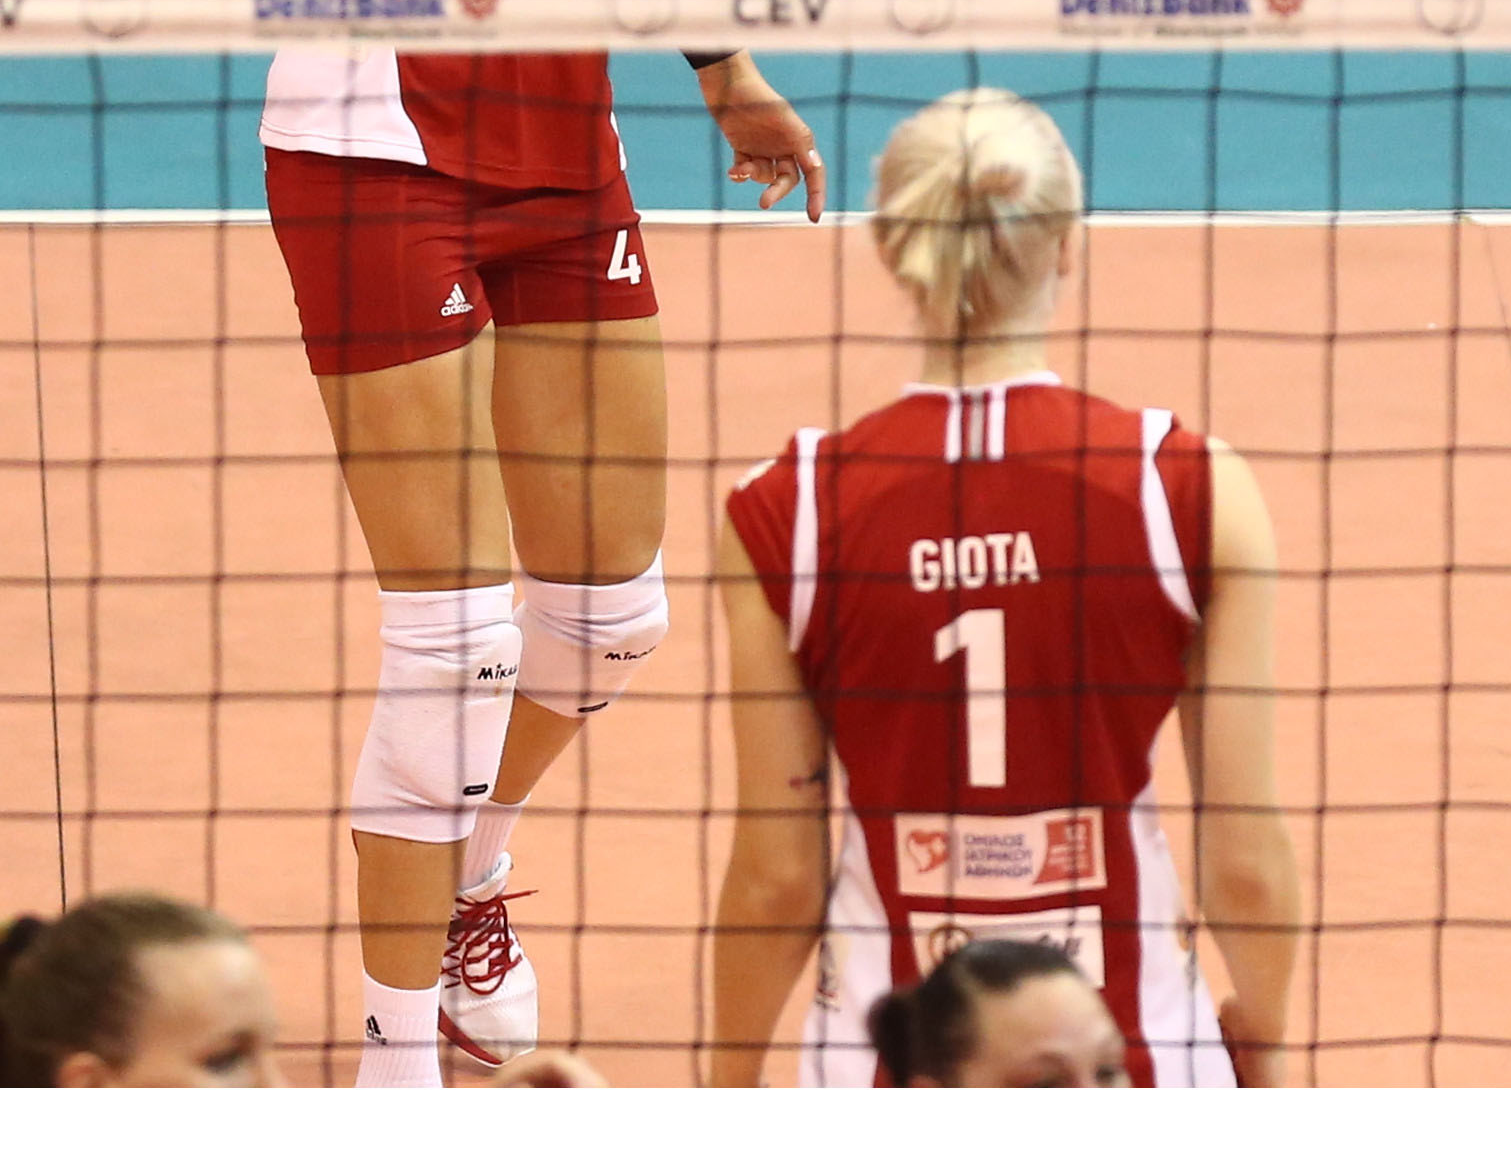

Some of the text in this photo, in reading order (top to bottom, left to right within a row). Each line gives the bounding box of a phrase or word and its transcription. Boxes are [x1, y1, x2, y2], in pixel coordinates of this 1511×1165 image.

[606, 229, 643, 285] 4
[909, 531, 1040, 593] GIOTA
[934, 608, 1006, 789] 1
